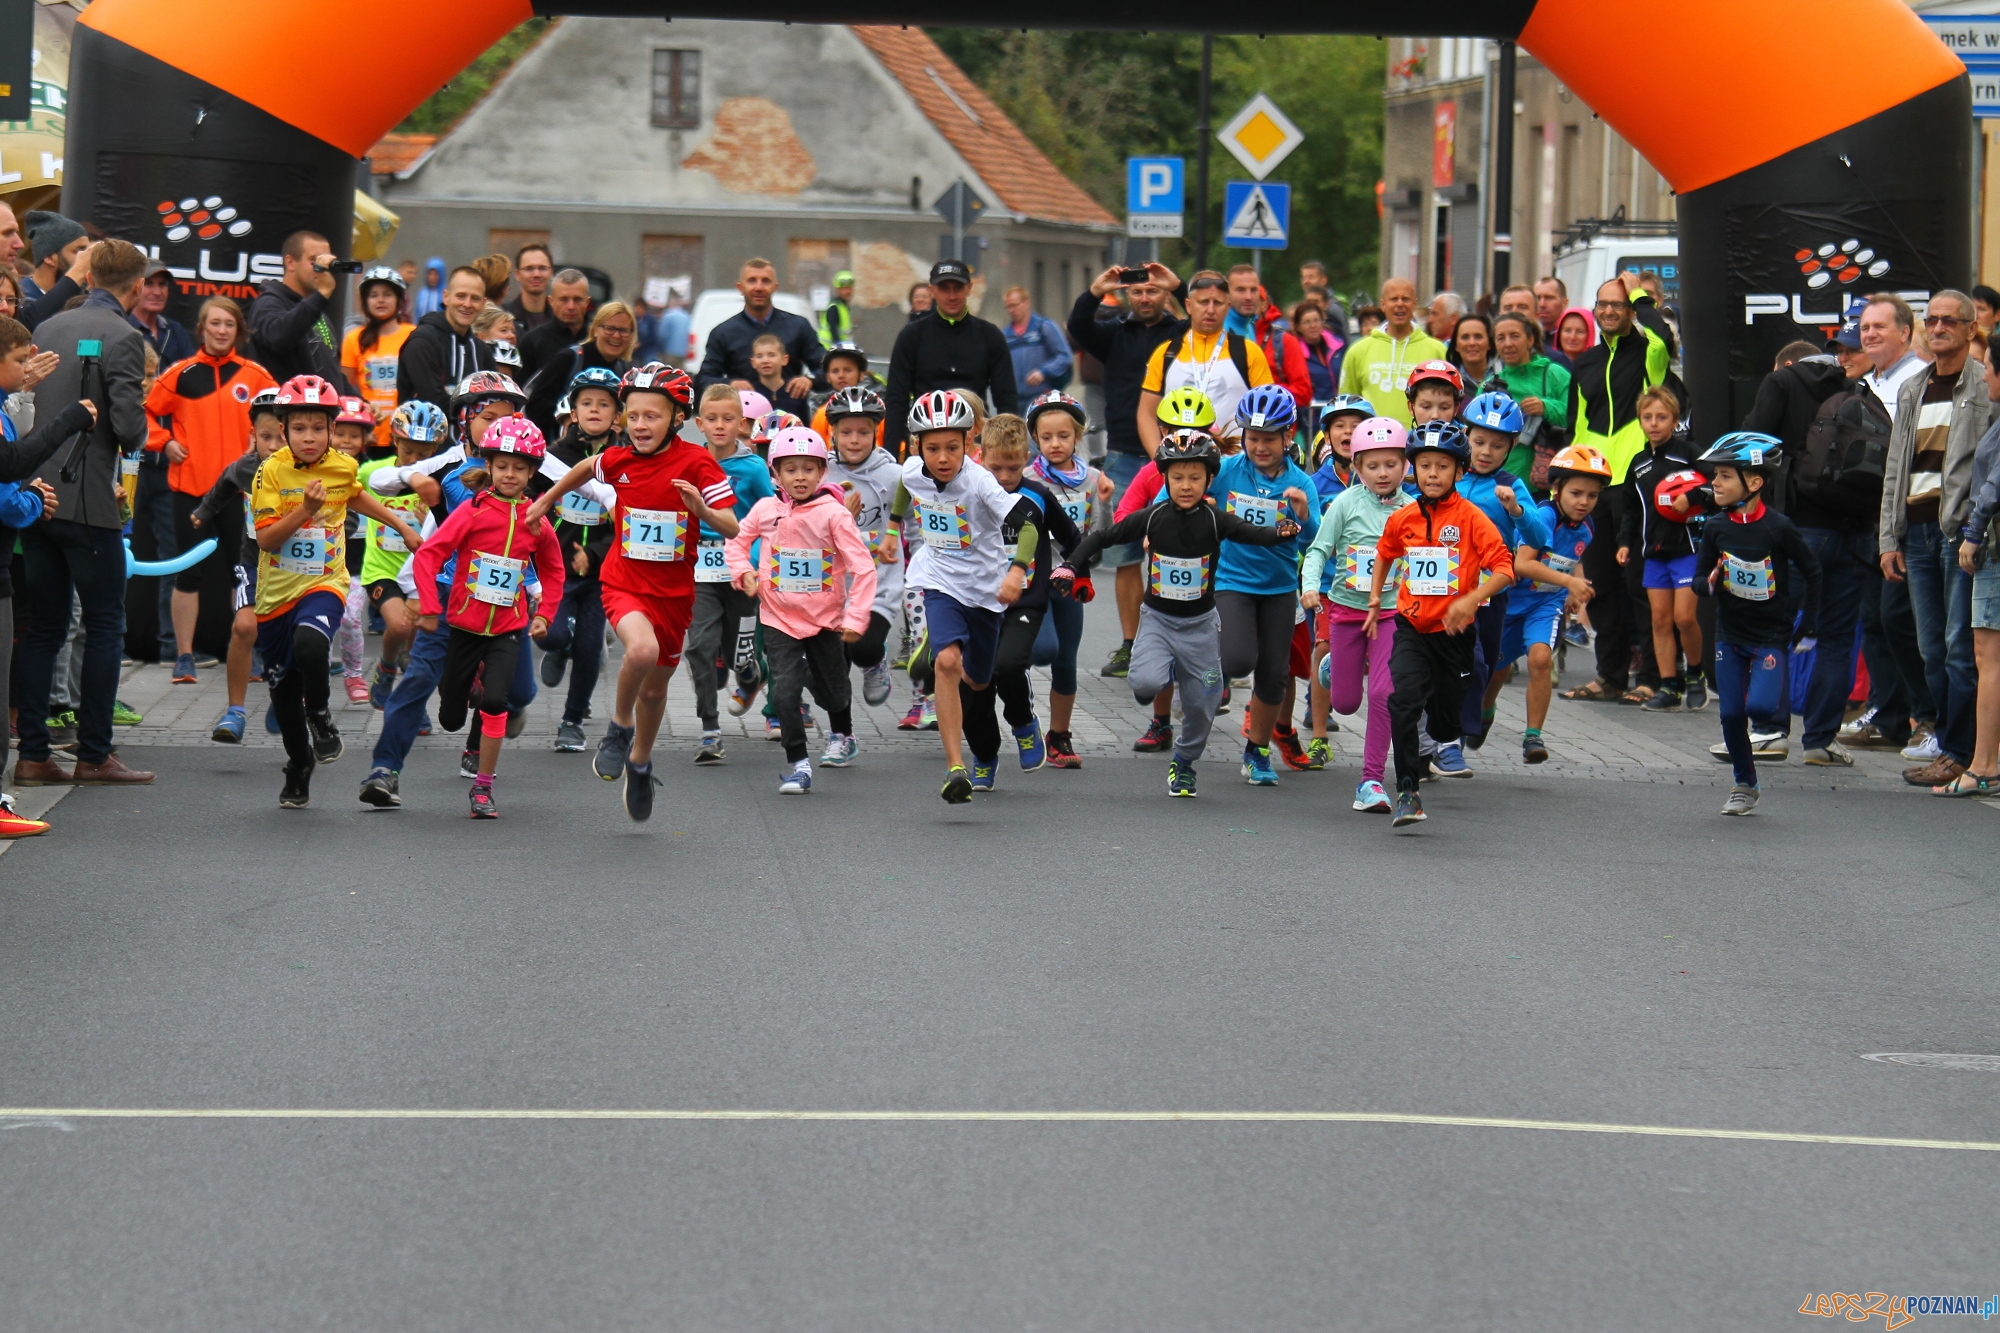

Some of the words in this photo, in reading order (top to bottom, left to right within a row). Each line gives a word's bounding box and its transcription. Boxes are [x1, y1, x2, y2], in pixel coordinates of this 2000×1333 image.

[1140, 165, 1173, 207] P
[134, 243, 284, 284] LUS
[378, 367, 395, 379] 95
[571, 494, 591, 510] 77
[929, 514, 948, 532] 85
[1244, 508, 1266, 525] 65
[640, 524, 664, 543] 71
[291, 542, 315, 559] 63
[704, 551, 725, 567] 68
[789, 561, 812, 577] 51
[1169, 569, 1192, 586] 69
[1416, 561, 1438, 578] 70
[487, 568, 512, 589] 52
[1737, 570, 1758, 587] 82
[1403, 600, 1420, 618] 22
